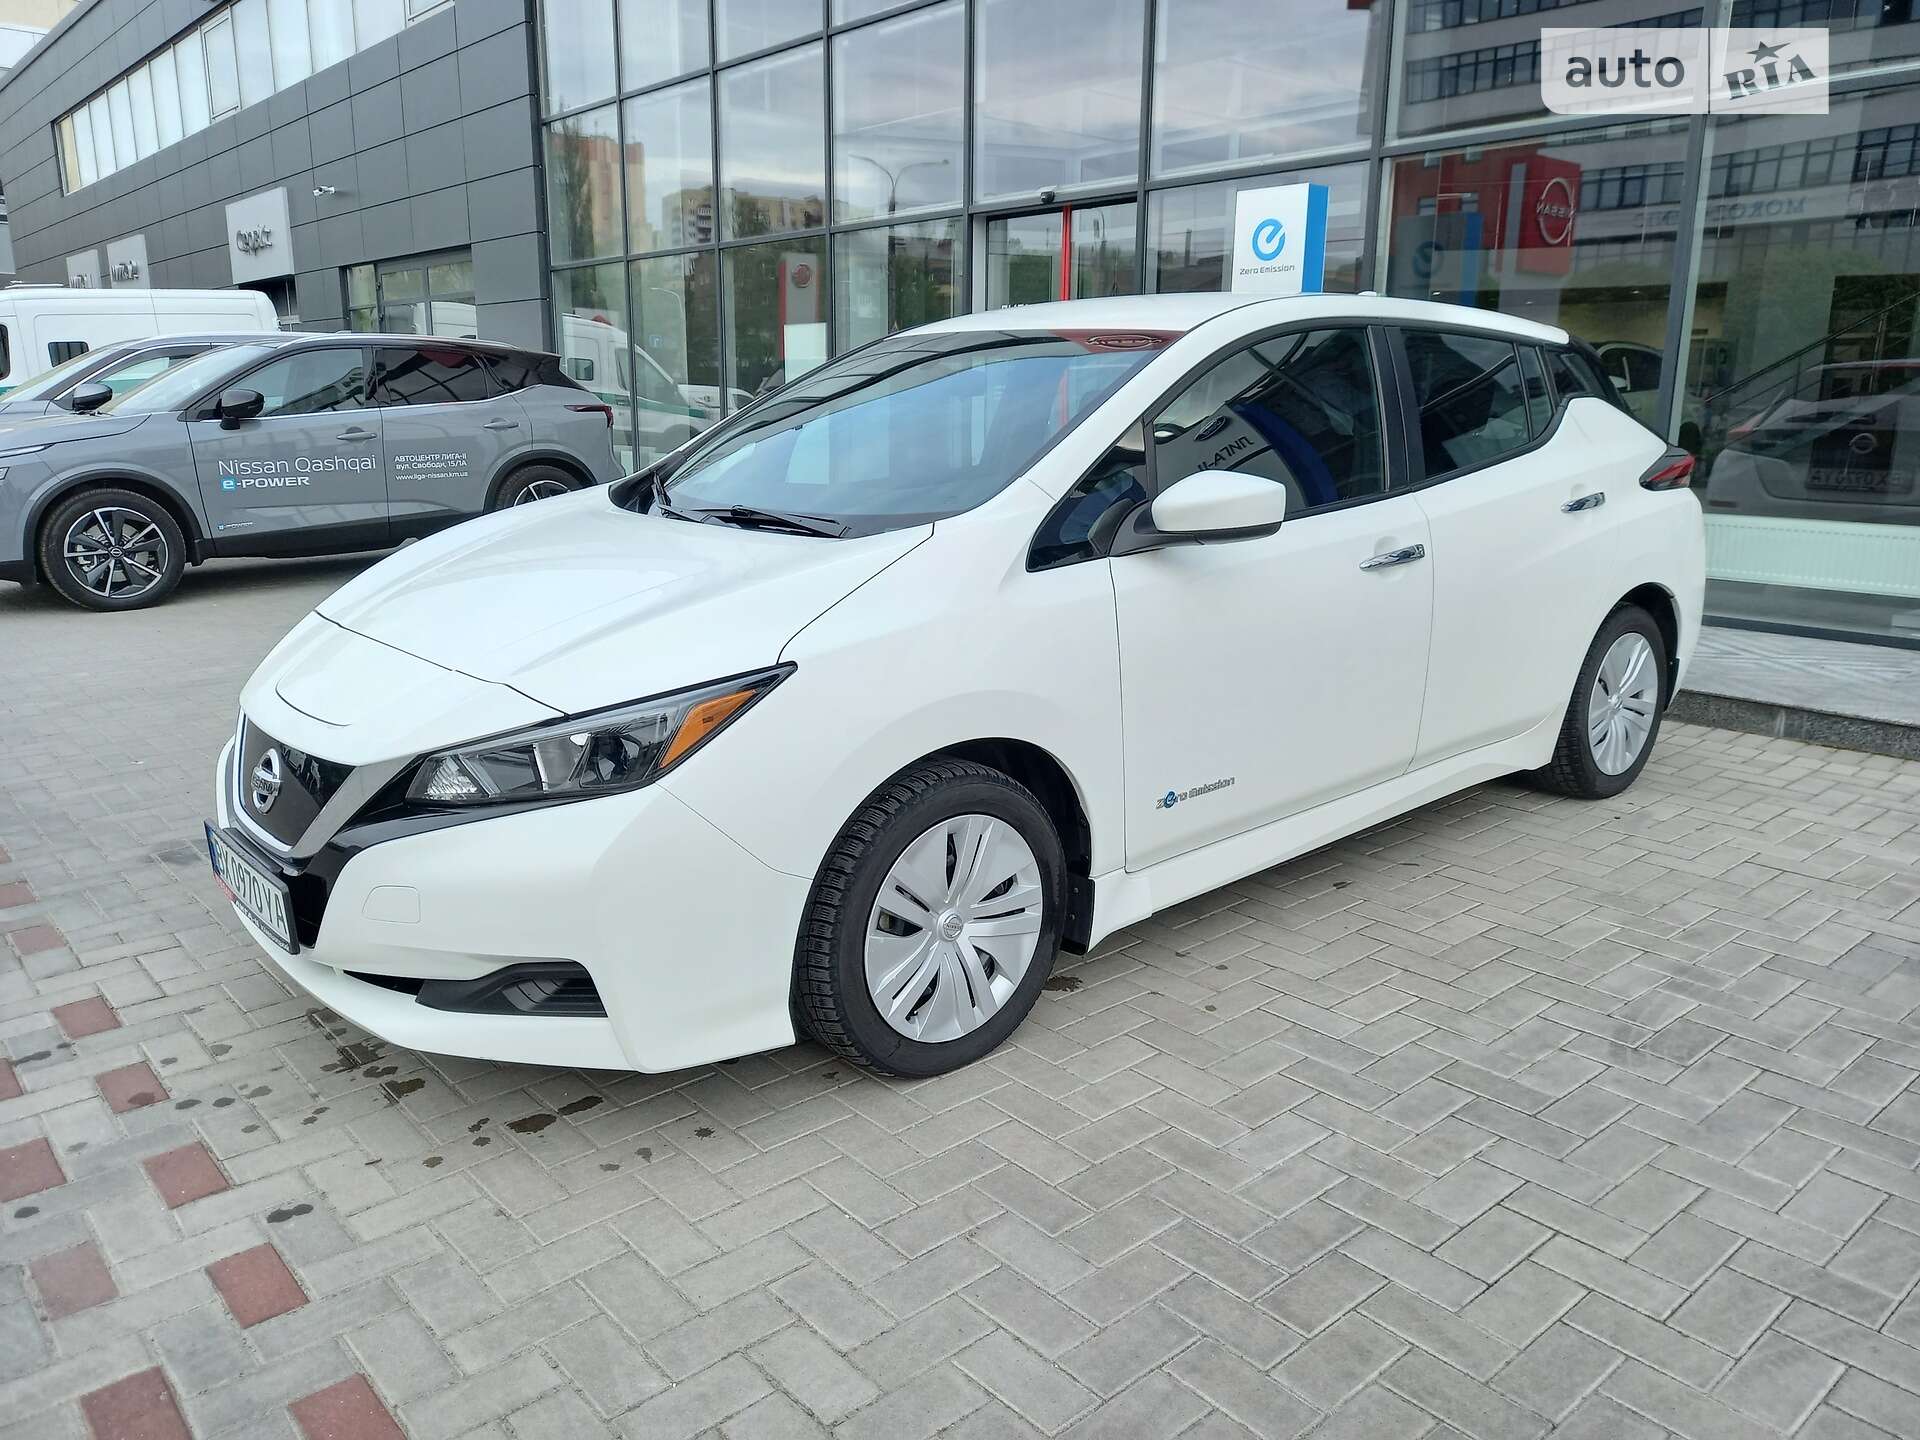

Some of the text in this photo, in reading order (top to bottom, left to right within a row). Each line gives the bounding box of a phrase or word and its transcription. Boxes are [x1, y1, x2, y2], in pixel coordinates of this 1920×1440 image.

[394, 453, 440, 462] АВТОЦЕНТР
[218, 455, 376, 475] Nissan Qashqai
[222, 476, 311, 490] e-POWER
